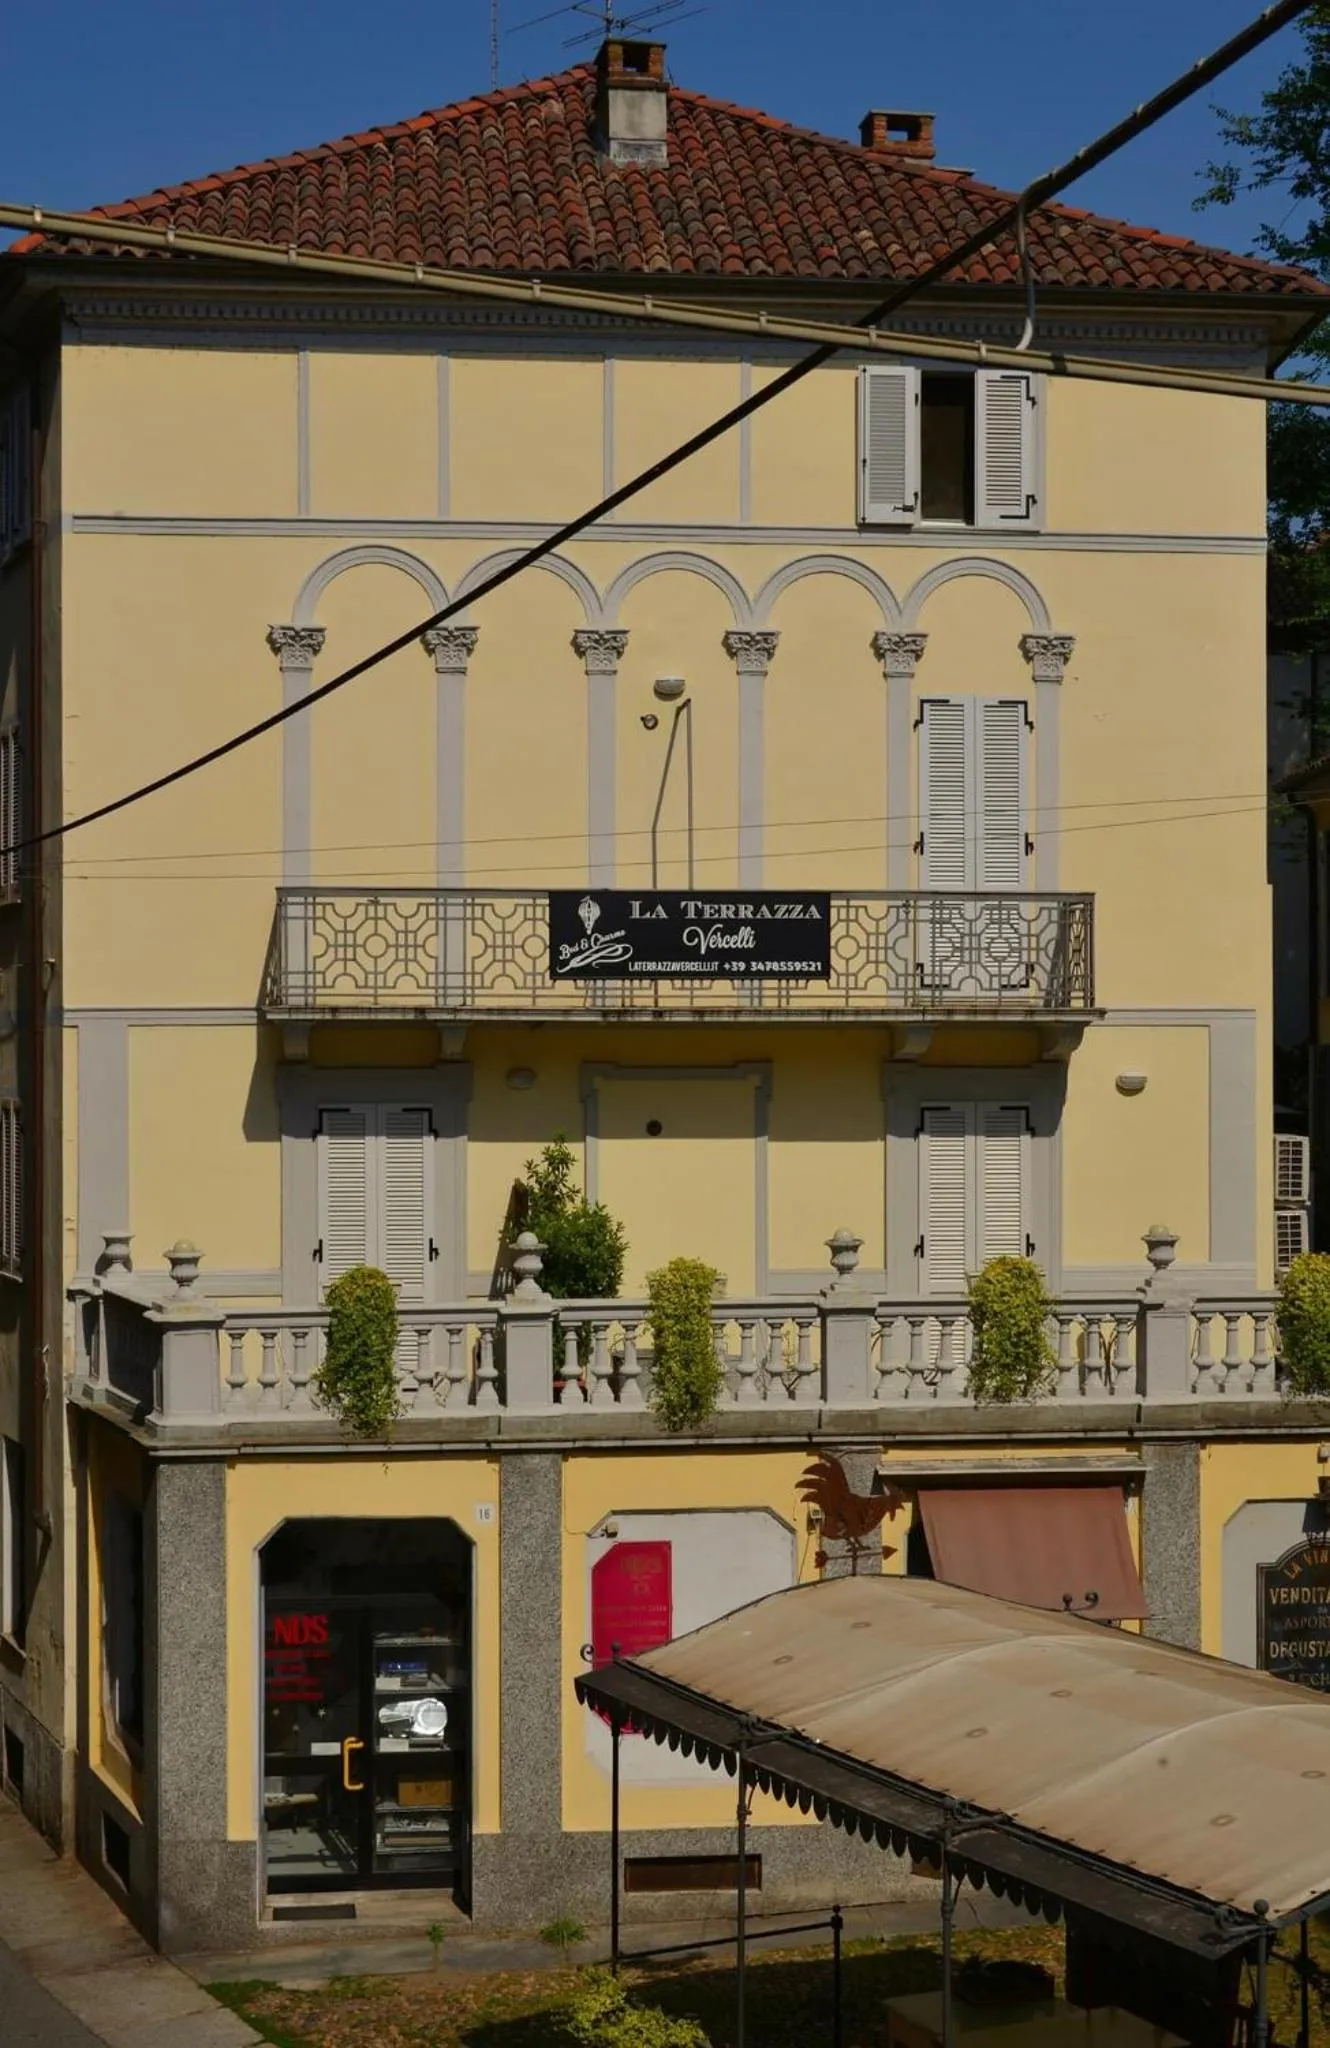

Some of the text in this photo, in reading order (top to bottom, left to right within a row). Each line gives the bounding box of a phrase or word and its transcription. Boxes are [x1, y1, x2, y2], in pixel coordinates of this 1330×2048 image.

[628, 900, 822, 919] LA TERRAZZA
[682, 924, 757, 955] Vercelli
[722, 961, 746, 972] +39
[479, 1508, 490, 1521] 16
